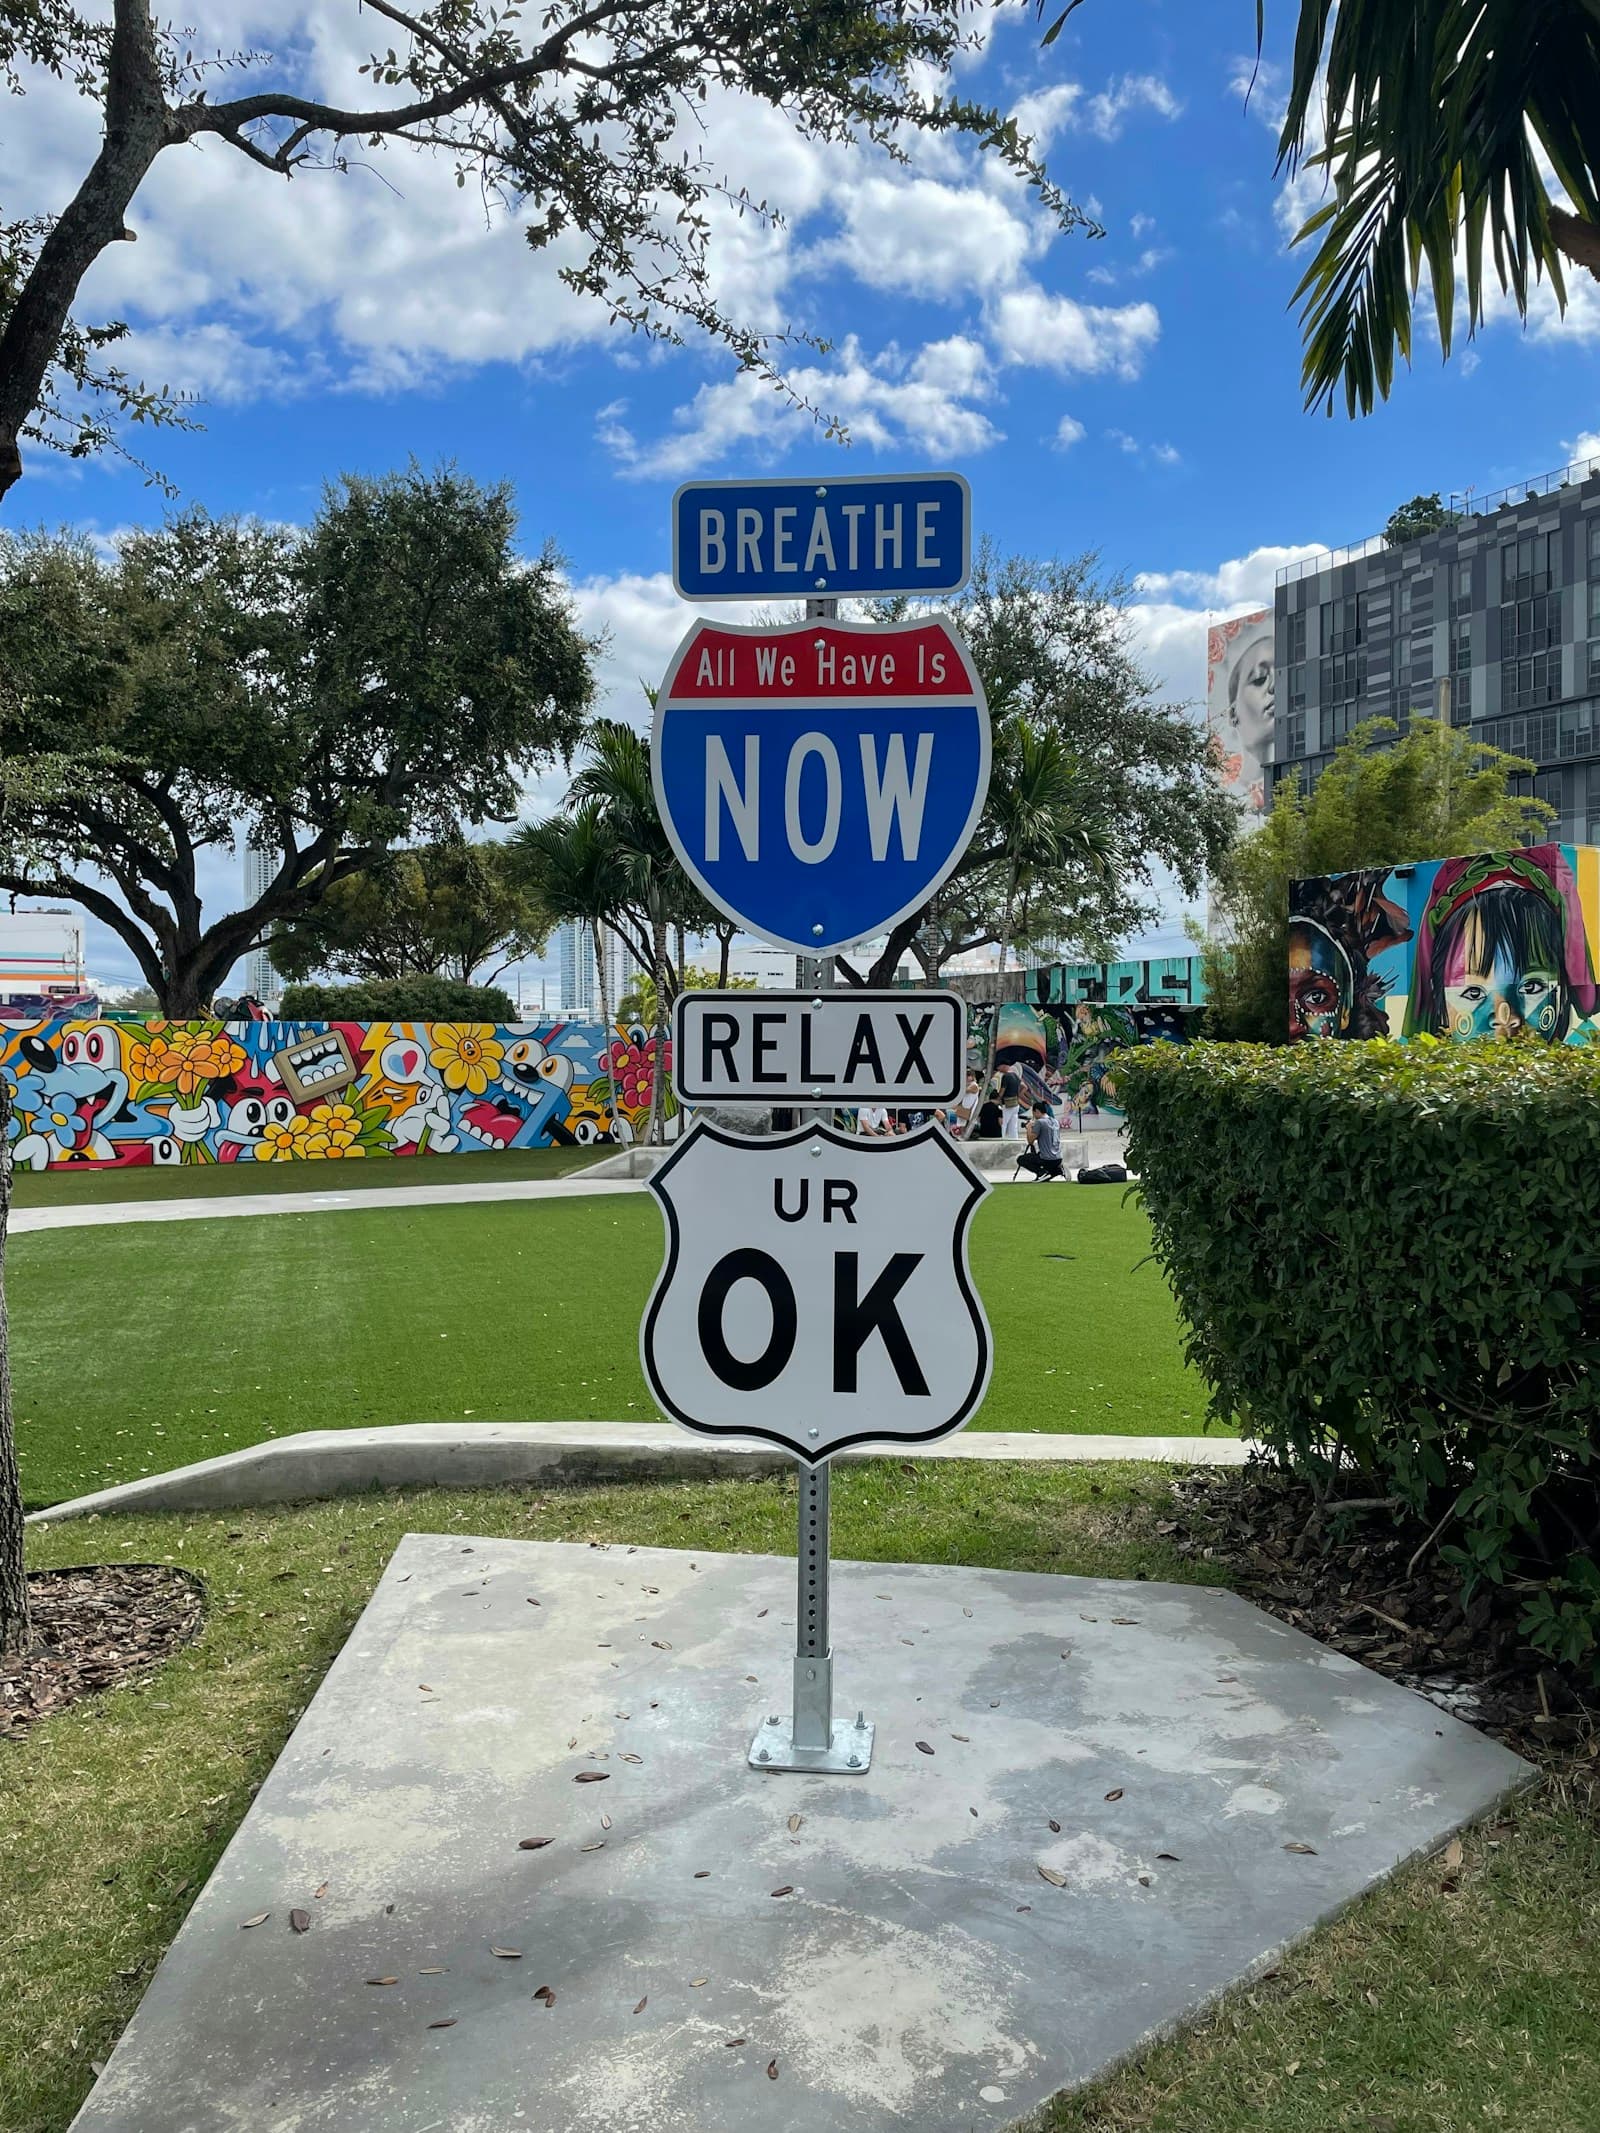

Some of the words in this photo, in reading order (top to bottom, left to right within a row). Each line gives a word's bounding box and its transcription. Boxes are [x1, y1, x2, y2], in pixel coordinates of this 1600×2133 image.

[699, 502, 941, 574] BREATHE
[695, 647, 736, 687] All
[755, 646, 797, 687] We
[818, 646, 896, 686] Have
[918, 644, 947, 684] Is
[704, 731, 935, 864] NOW
[702, 1013, 936, 1084] RELAX
[773, 1177, 858, 1224] UR
[698, 1247, 932, 1397] OK
